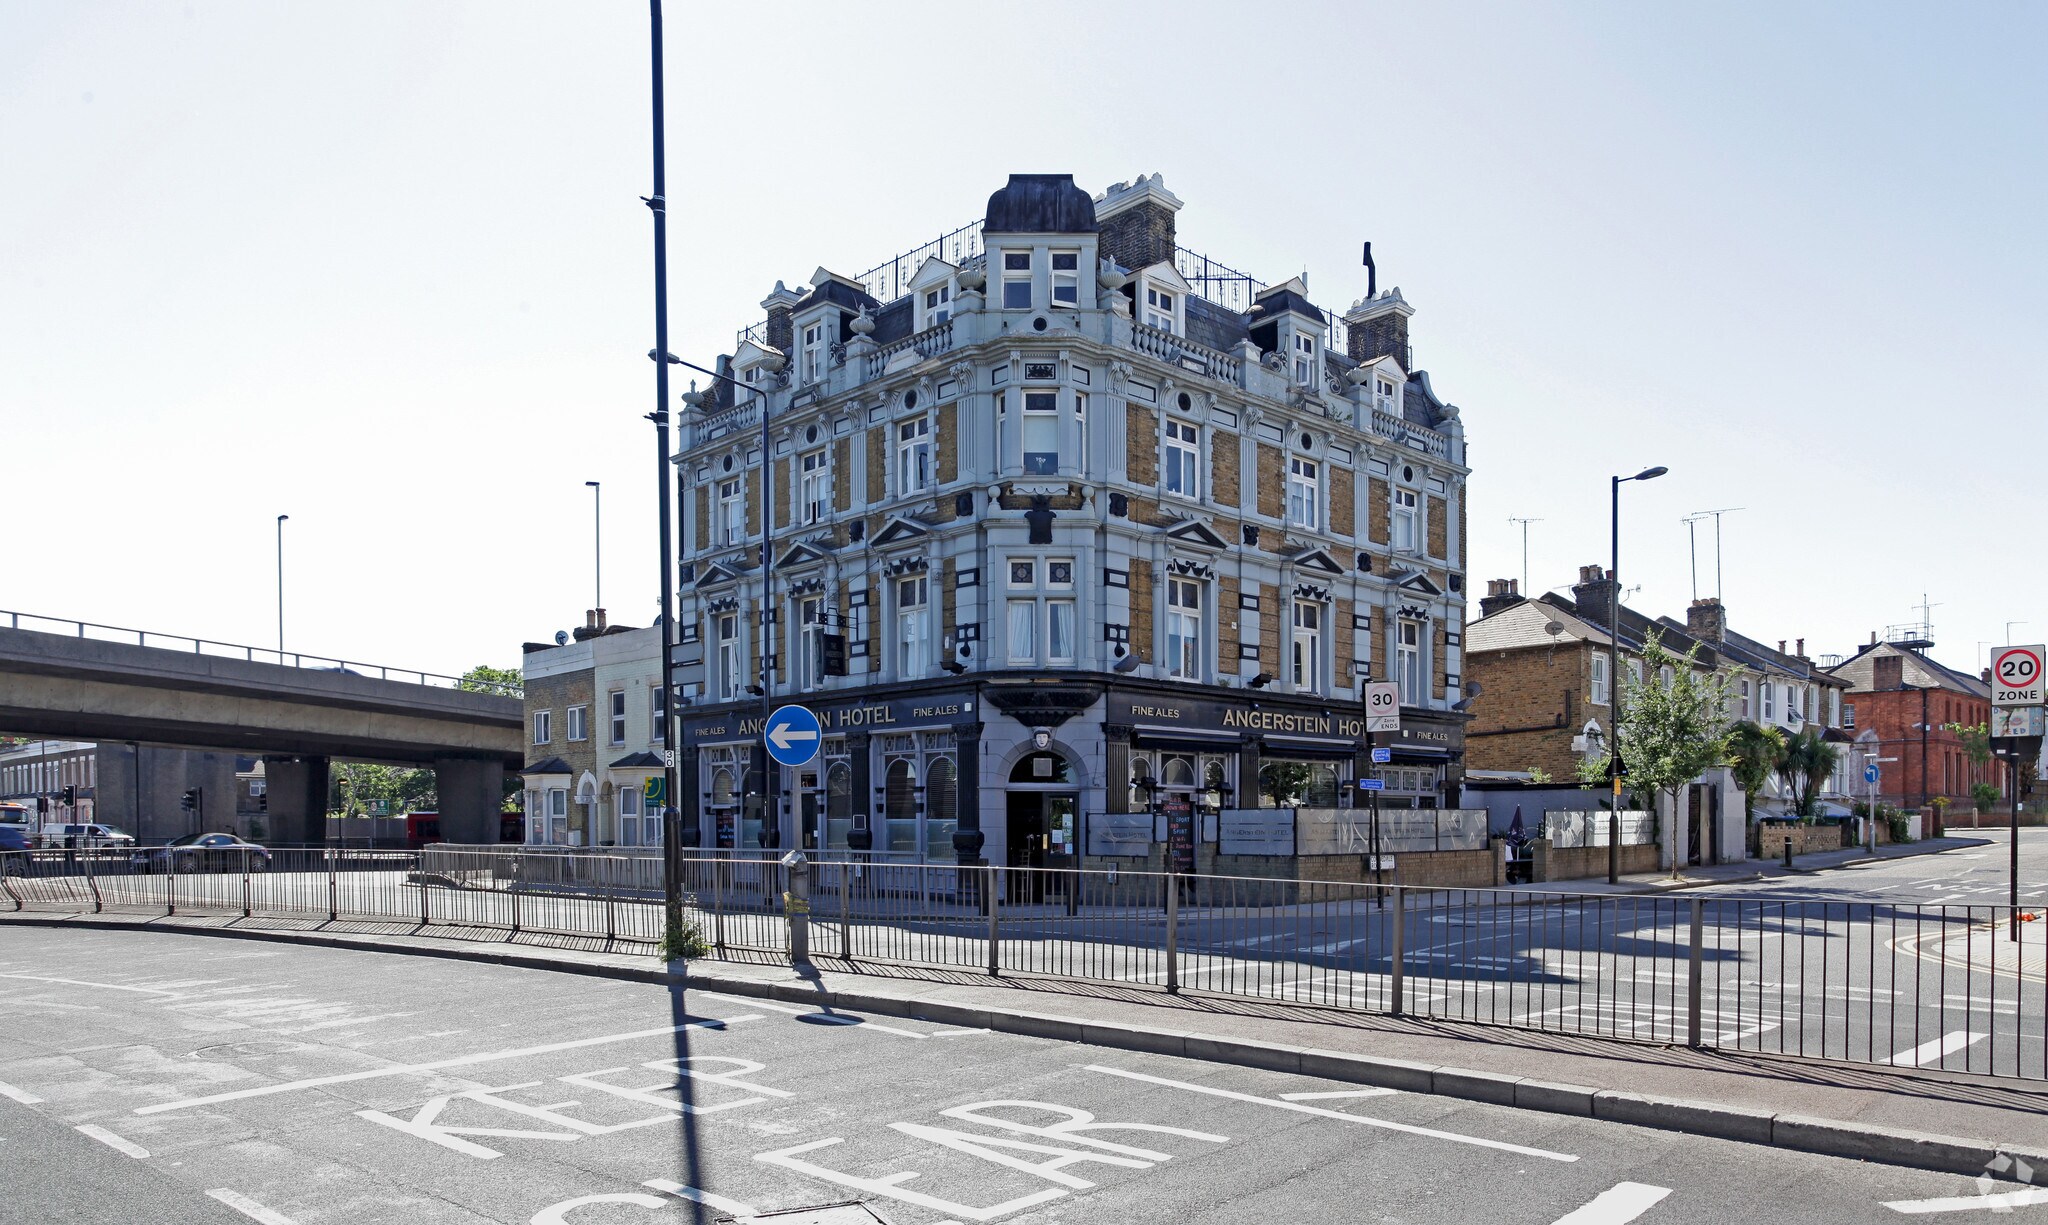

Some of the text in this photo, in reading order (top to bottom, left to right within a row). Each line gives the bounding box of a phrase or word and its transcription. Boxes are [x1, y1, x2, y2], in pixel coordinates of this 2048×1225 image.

[2002, 660, 2034, 677] 20
[1372, 693, 1393, 706] 30
[1998, 690, 2037, 701] ZONE
[839, 705, 896, 726] HOTEL
[913, 705, 958, 718] FINE ALES
[1131, 706, 1180, 718] FINE ALES
[1222, 710, 1364, 736] ANGERSTEIN HOT
[695, 726, 726, 736] FINE ALES
[1432, 733, 1448, 741] ALES
[354, 1056, 798, 1159] KEEP
